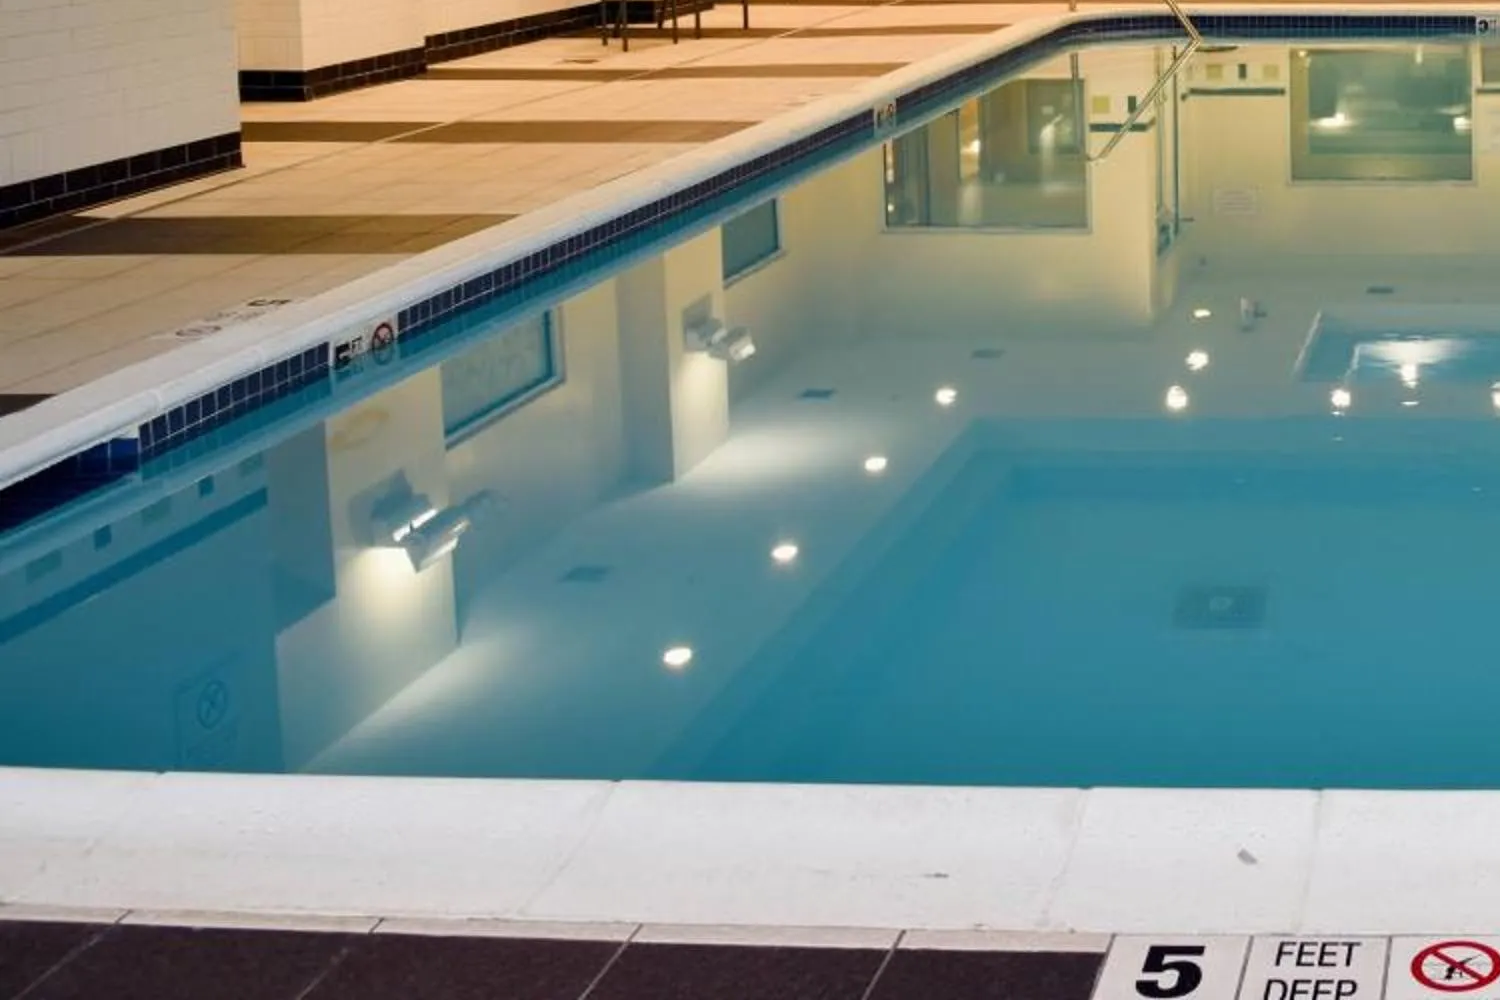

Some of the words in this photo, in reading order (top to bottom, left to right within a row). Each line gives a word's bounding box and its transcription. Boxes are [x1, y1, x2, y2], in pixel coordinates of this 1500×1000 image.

[1135, 945, 1207, 999] 5
[1274, 941, 1361, 967] FEET
[1263, 979, 1358, 1000] DEEP
